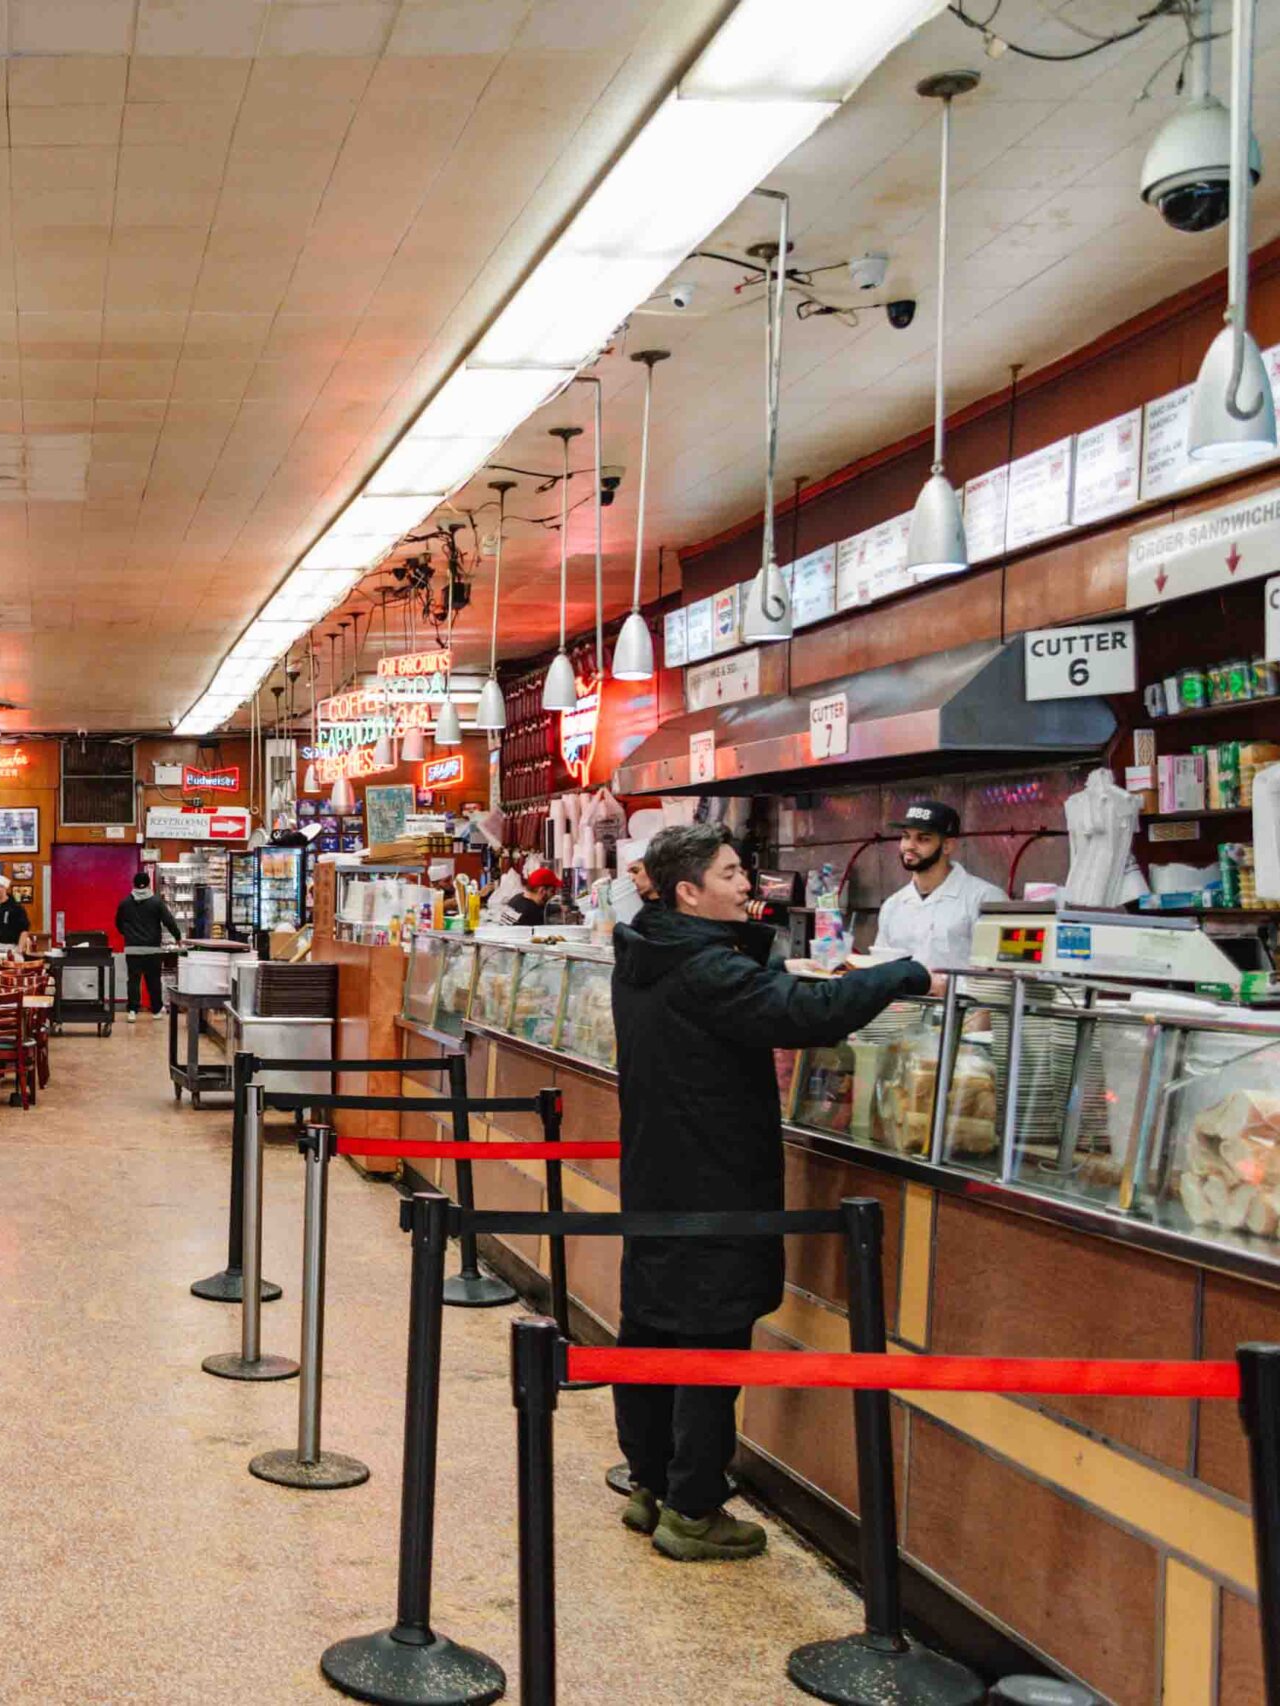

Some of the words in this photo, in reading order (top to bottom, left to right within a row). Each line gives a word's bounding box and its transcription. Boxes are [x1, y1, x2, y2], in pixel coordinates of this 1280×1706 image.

[1030, 631, 1127, 657] CUTTER
[1069, 658, 1090, 686] 6
[812, 701, 845, 724] CUTTER
[825, 724, 833, 757] 7
[186, 774, 235, 786] Budweiser
